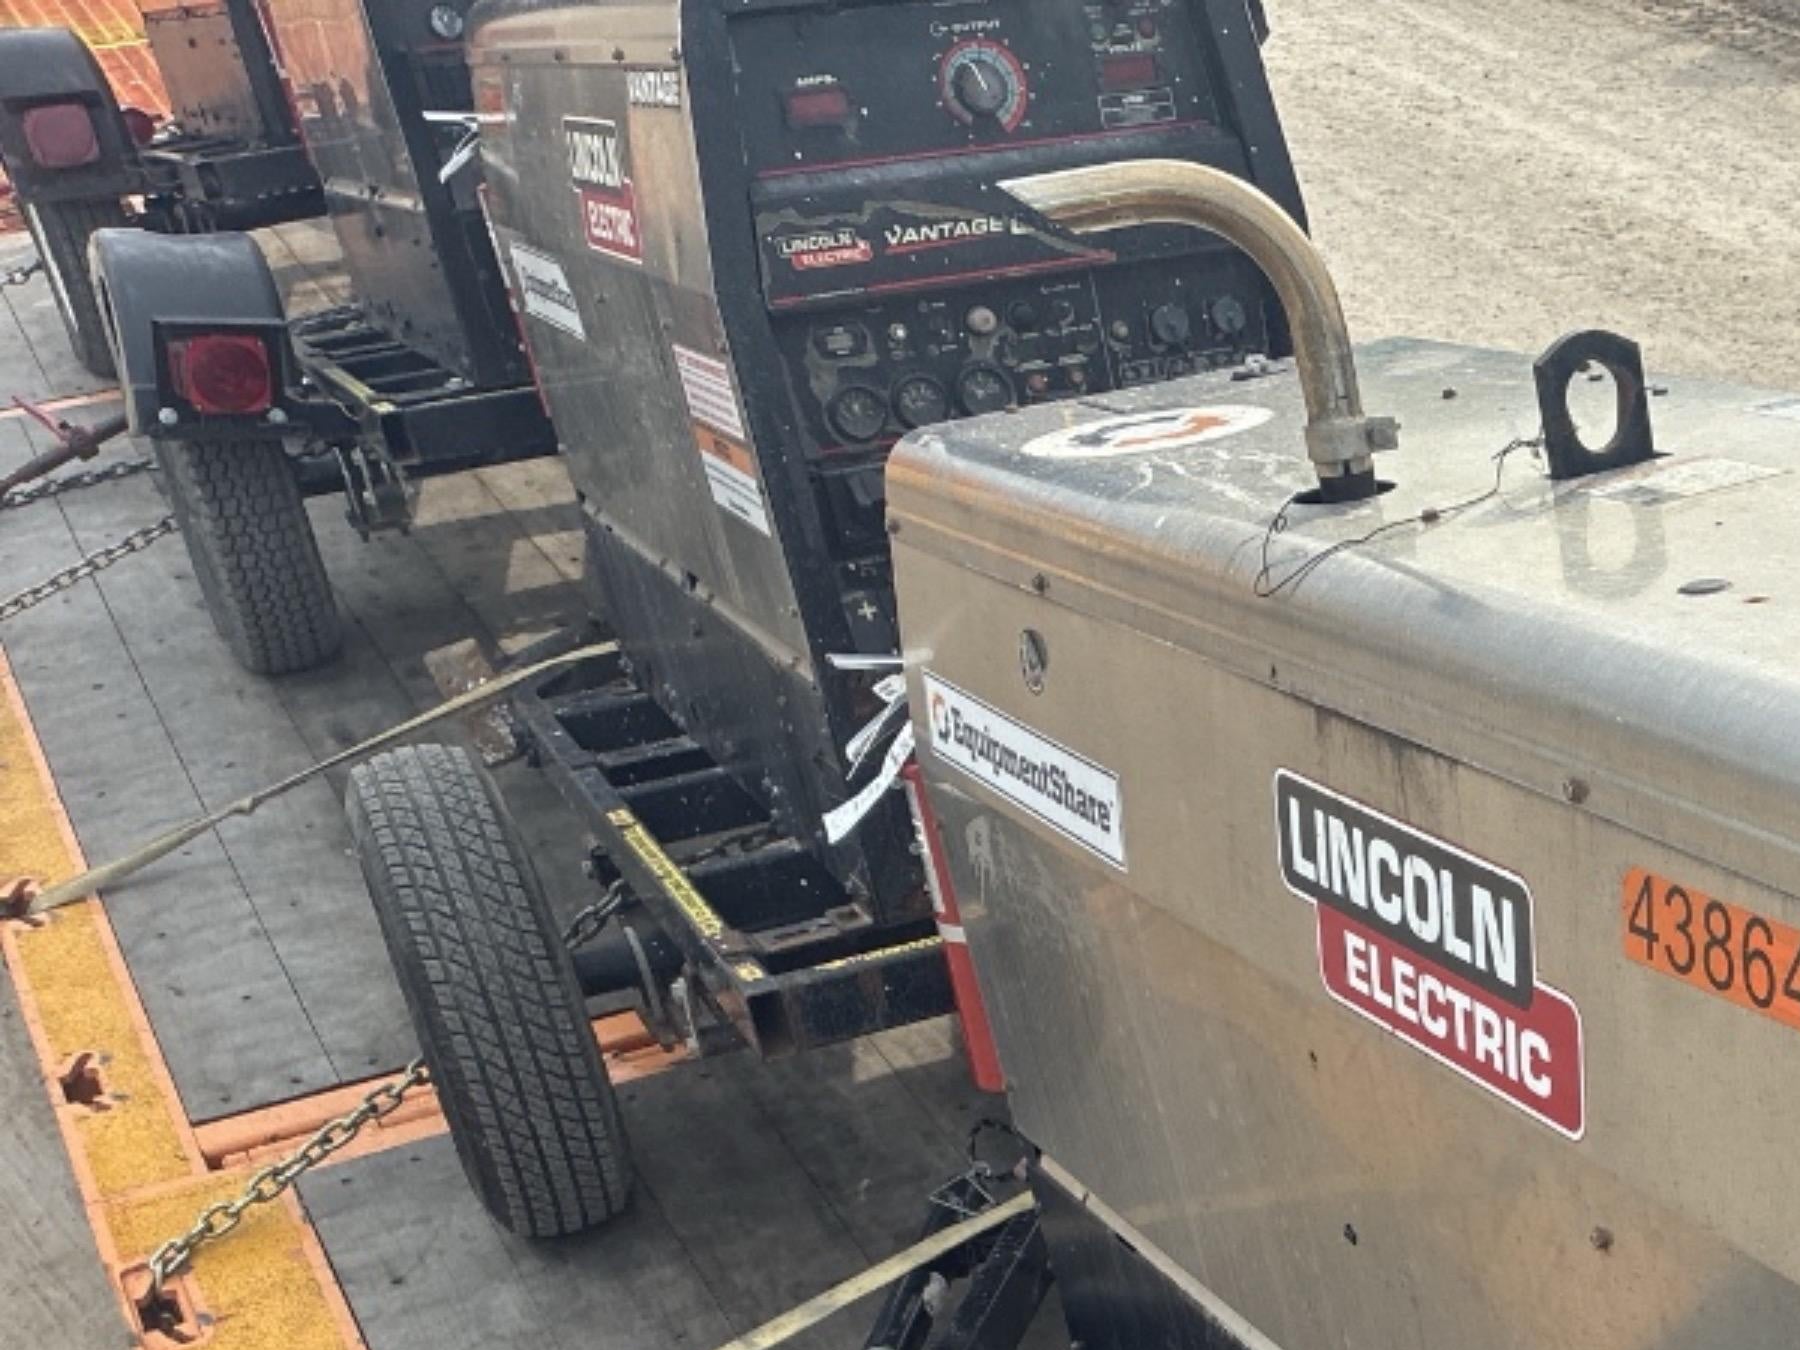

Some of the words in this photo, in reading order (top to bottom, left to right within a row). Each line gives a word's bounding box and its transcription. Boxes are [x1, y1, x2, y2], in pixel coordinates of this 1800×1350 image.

[781, 230, 853, 253] LINCOLN
[884, 216, 1004, 245] VANTAGE
[950, 706, 1113, 833] EquipmentShare
[1288, 797, 1517, 989] LINCOLN
[1345, 931, 1552, 1099] ELECTRIC
